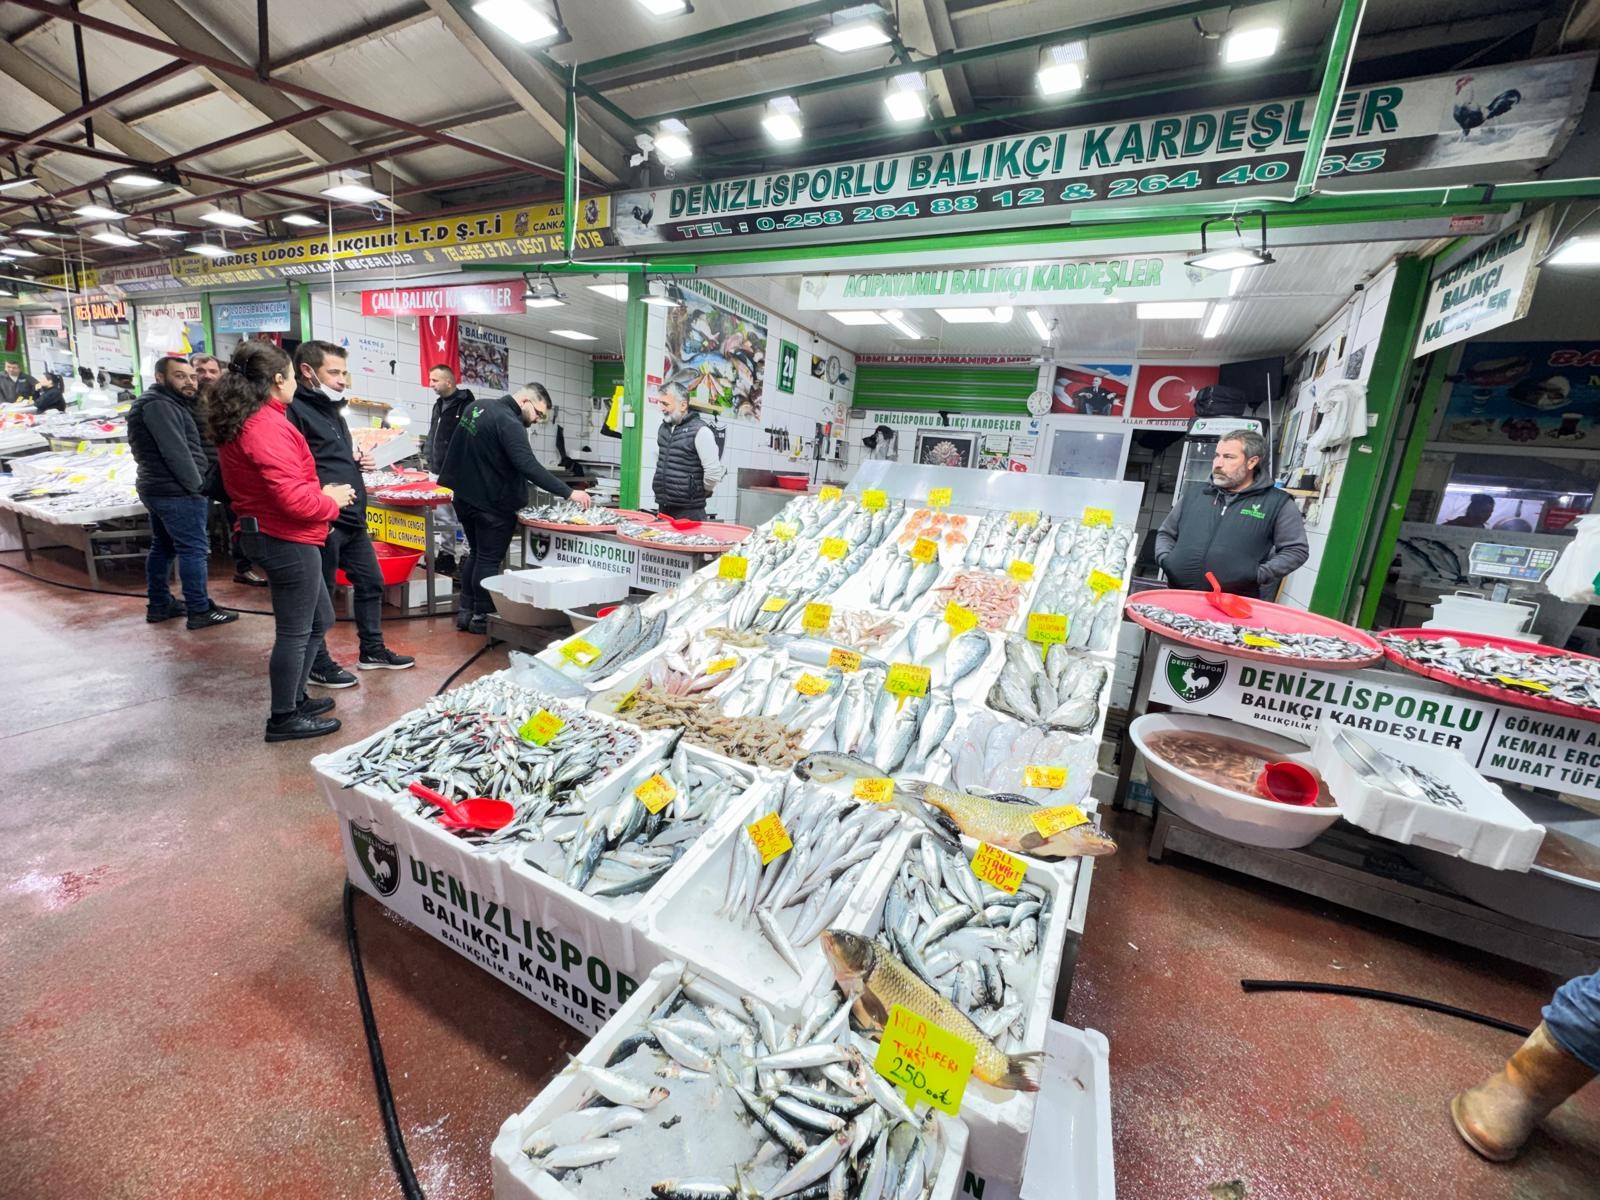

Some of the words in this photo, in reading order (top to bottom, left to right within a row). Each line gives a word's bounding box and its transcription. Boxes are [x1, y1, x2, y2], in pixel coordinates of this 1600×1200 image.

[908, 134, 1068, 190] BALIKÇI
[1080, 86, 1404, 170] KARDEŞLER
[677, 222, 732, 238] TEL
[756, 210, 844, 231] 0.258
[853, 201, 920, 221] 264
[931, 196, 979, 214] 88
[993, 188, 1045, 207] 12
[1060, 183, 1097, 201] &
[1107, 170, 1202, 199] 264
[1216, 161, 1290, 185] 40
[1317, 149, 1387, 176] 65
[212, 253, 258, 267] KARDEŞ
[262, 246, 305, 262] LODOS
[310, 232, 398, 255] BALIKÇILIK
[279, 262, 310, 276] KREDİ
[345, 251, 415, 270] GEÇERLİDİR
[951, 266, 1028, 298] BALIKÇI
[1031, 258, 1164, 295] KARDEŞLER
[1440, 263, 1504, 313] BALIKÇI
[402, 290, 443, 313] BALIKÇI
[783, 355, 795, 379] 20
[874, 412, 937, 426] DENİZLİSPORLU
[971, 418, 1021, 431] KARDEŞLER
[555, 536, 635, 564] DENİZLİSPORLU
[1238, 666, 1483, 732] DENİZLİSPORLU
[1241, 692, 1323, 721] BALIKÇI
[1329, 710, 1463, 750] KARDEŞLER
[1254, 712, 1313, 731] BALIKÇILIK
[1505, 715, 1580, 743] GÖKHAN
[1498, 734, 1557, 760] KEMAL
[1491, 754, 1555, 779] MURAT
[421, 894, 510, 958] BALIKÇI
[441, 928, 505, 975] BALIKÇILIK
[508, 971, 538, 995] SAN.
[536, 991, 558, 1008] VE
